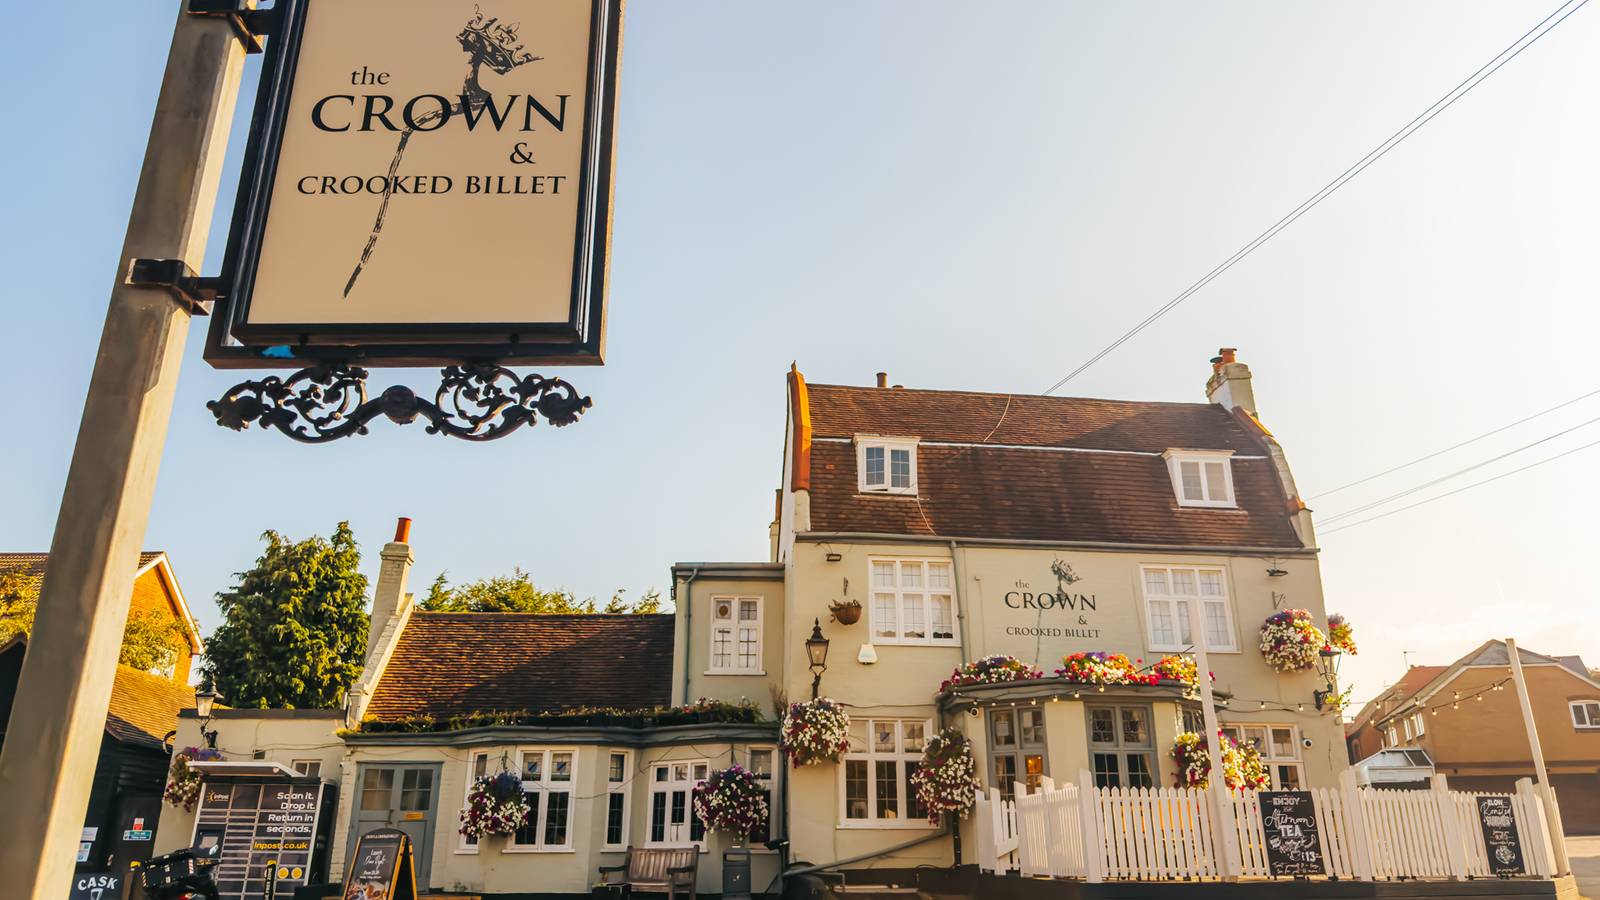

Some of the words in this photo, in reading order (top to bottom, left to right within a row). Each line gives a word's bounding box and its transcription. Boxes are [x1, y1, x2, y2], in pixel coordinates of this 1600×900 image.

[351, 66, 390, 86] the
[311, 94, 571, 132] CROWN
[509, 142, 536, 165] &
[297, 175, 453, 194] CROOKED
[465, 175, 566, 194] BILLET
[1015, 579, 1030, 589] the
[1004, 591, 1096, 611] CROWN
[1078, 614, 1088, 625] &
[1006, 626, 1061, 638] CROOKED
[1065, 628, 1100, 638] BILLET
[277, 791, 304, 800] Scan
[305, 791, 315, 800] it.
[1272, 797, 1300, 806] ENJOY
[280, 802, 306, 812] Drop
[306, 802, 316, 810] it.
[268, 813, 304, 822] Return
[304, 813, 313, 822] in
[266, 824, 311, 833] seconds.
[1279, 825, 1302, 837] TEA
[77, 875, 118, 891] CASK
